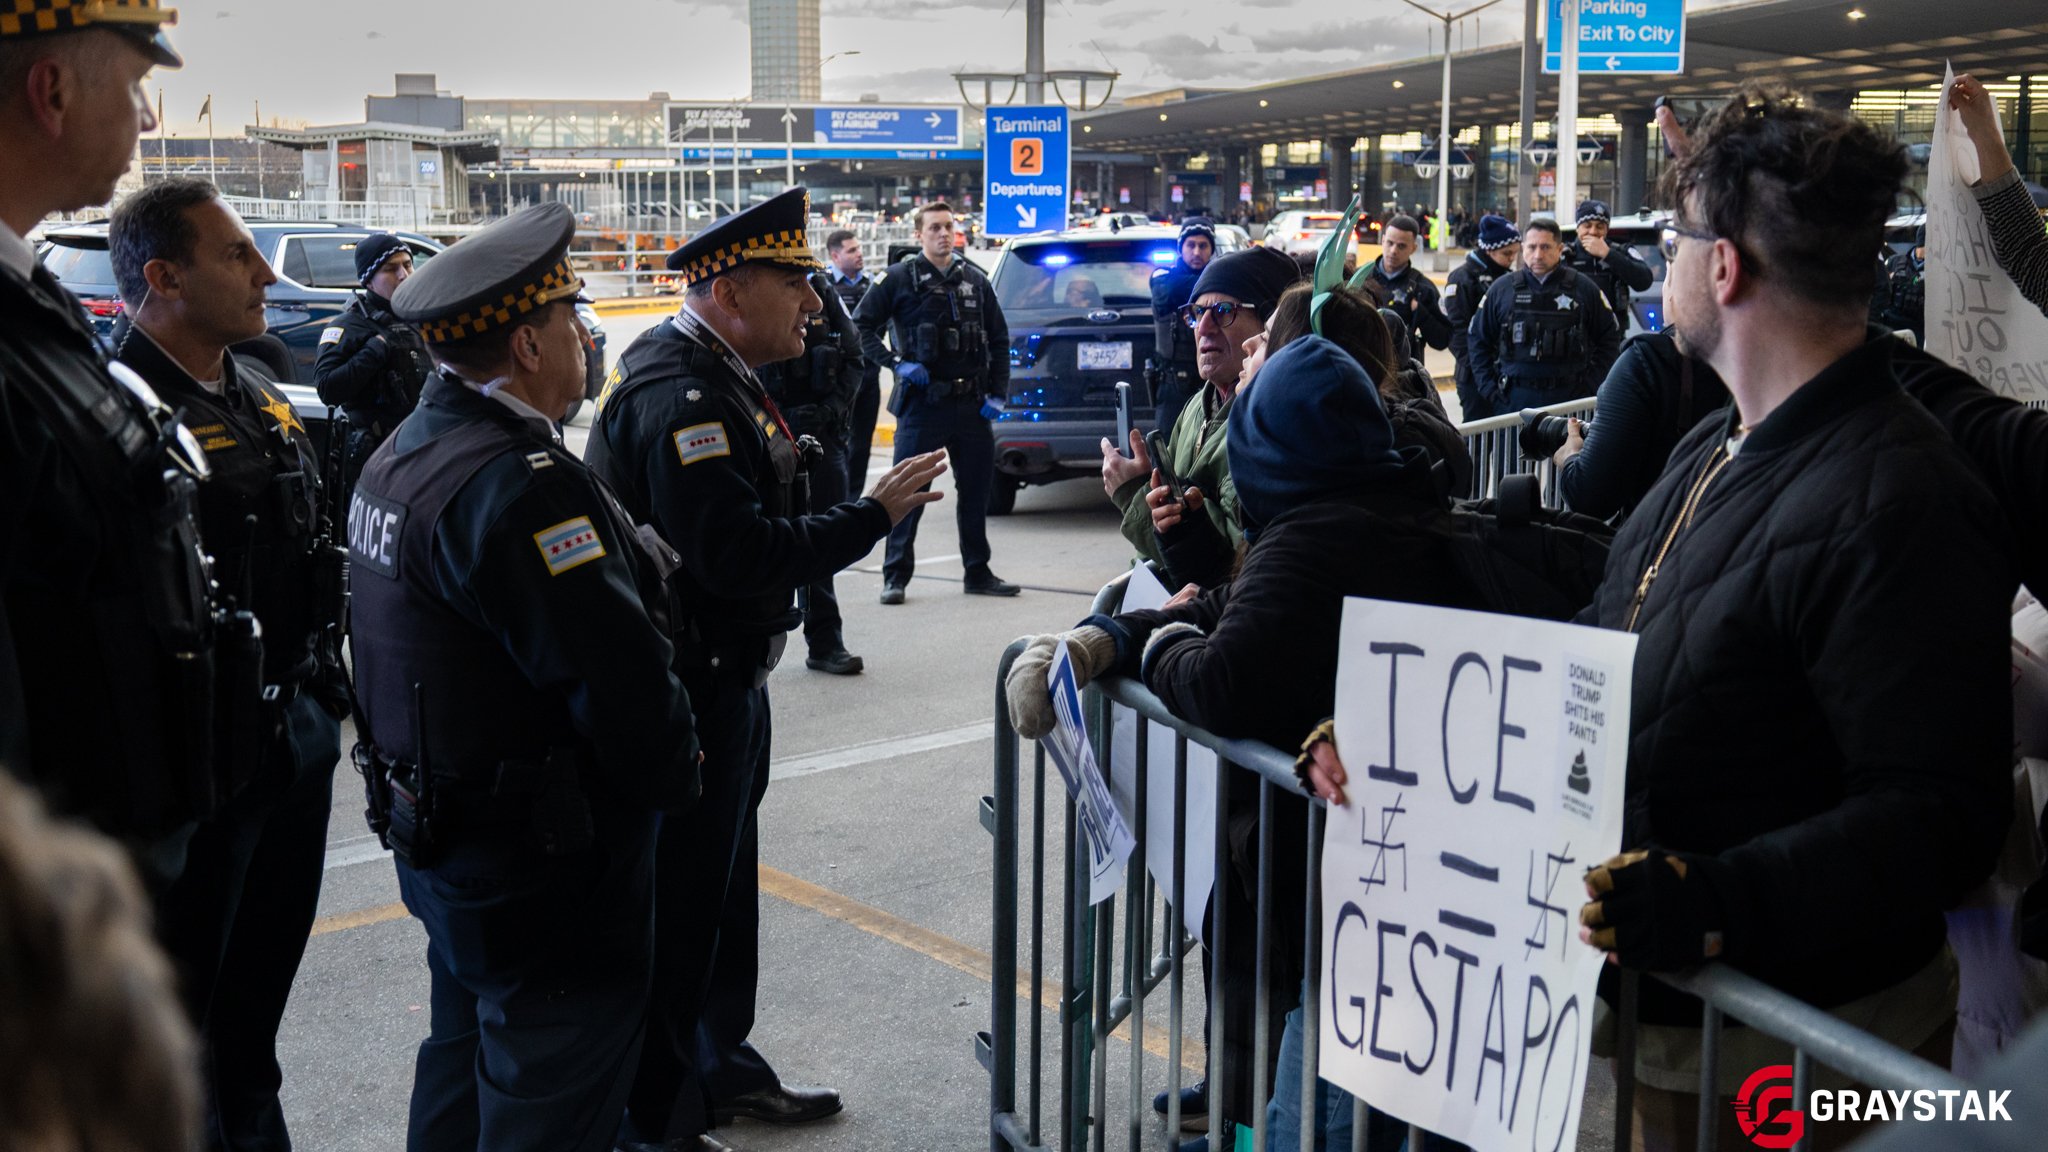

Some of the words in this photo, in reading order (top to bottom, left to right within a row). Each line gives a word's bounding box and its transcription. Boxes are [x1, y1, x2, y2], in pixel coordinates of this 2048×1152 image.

[1581, 0, 1647, 18] Parking
[1580, 25, 1613, 41] Exit
[1615, 25, 1636, 41] To
[1639, 25, 1675, 44] City
[831, 111, 845, 119] FLY
[993, 116, 1062, 133] Terminal
[1020, 145, 1034, 168] 2
[990, 182, 1063, 198] Departures
[347, 492, 398, 567] POLICE
[1569, 662, 1606, 687] DONALD
[1571, 682, 1602, 704] TRUMP
[1564, 699, 1589, 721] SHITS
[1590, 709, 1606, 727] HIS
[1369, 640, 1543, 813] ICE
[1568, 720, 1597, 745] PANTS
[1331, 900, 1581, 1152] GESTAPO
